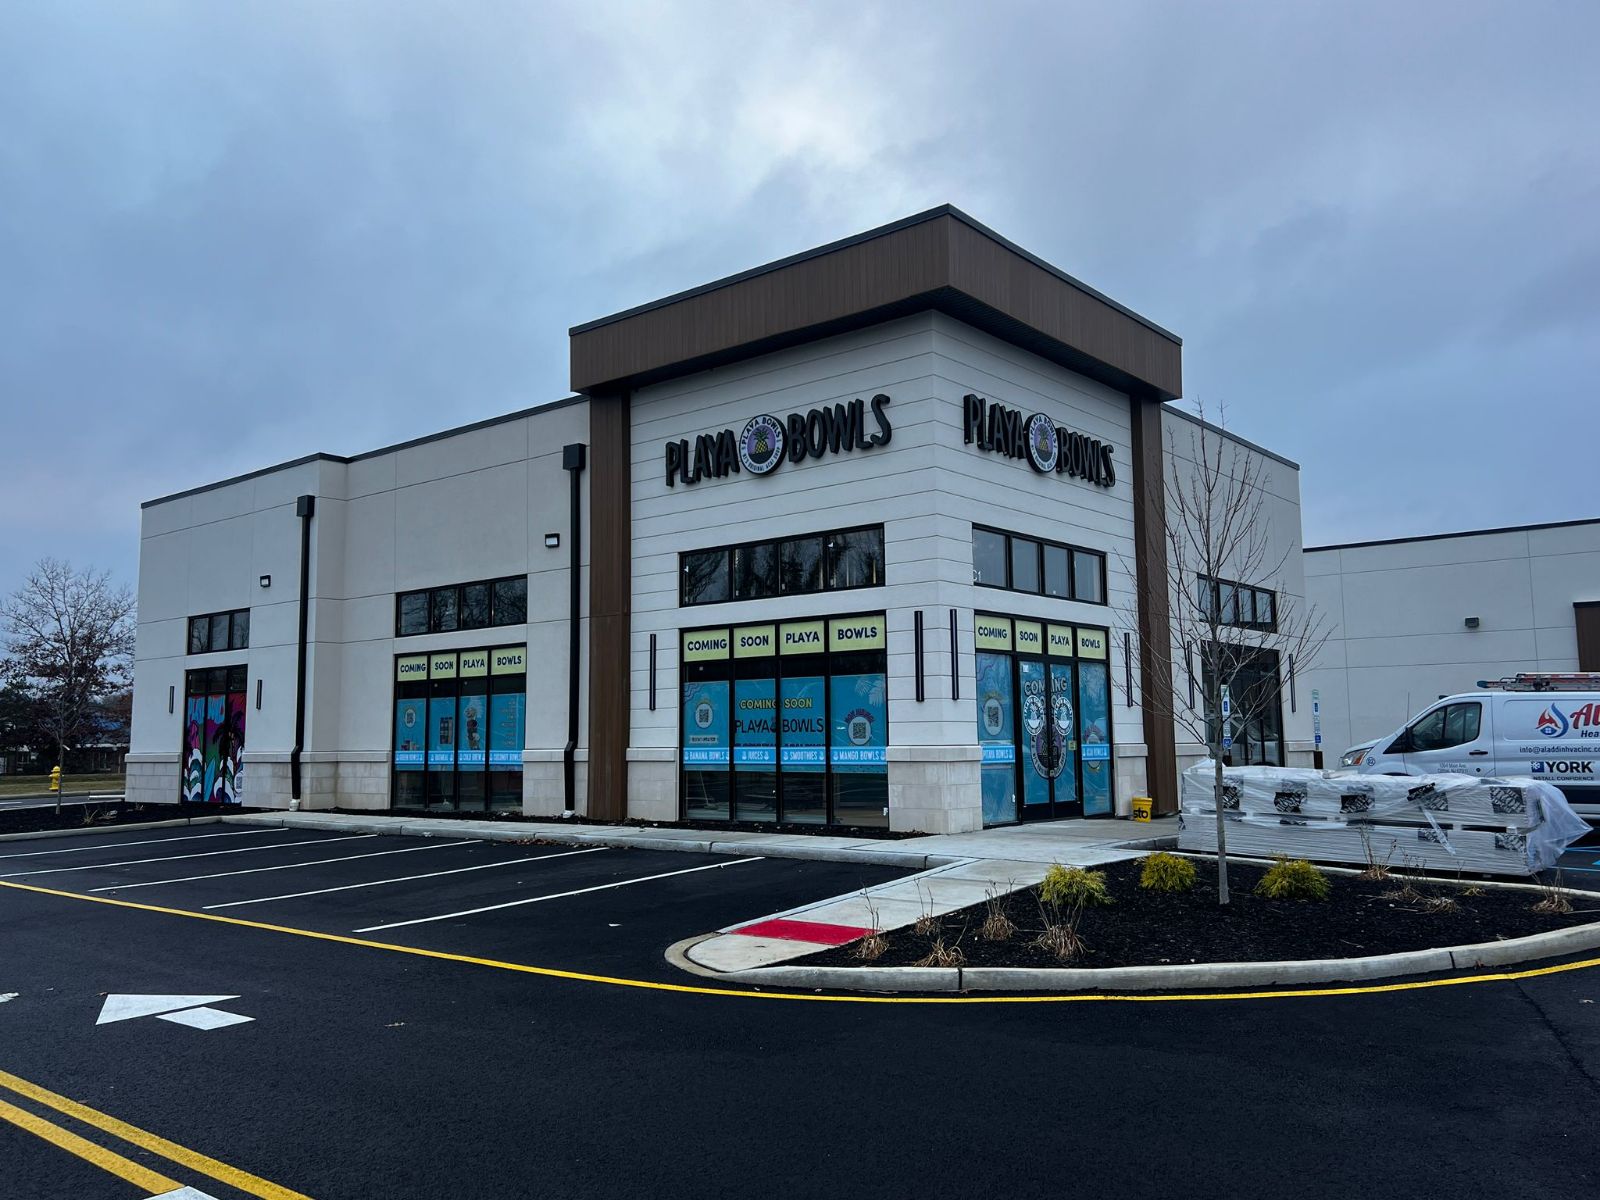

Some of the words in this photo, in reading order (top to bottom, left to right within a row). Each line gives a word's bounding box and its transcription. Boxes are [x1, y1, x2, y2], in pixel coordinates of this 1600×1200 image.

[742, 419, 760, 445] PLAYA
[762, 417, 781, 438] BOWLS
[665, 429, 740, 487] PLAYA
[787, 393, 892, 464] BOWLS
[963, 394, 1027, 459] PLAYA
[1056, 427, 1115, 487] BOWLS
[687, 638, 727, 652] COMING
[740, 635, 769, 647] SOON
[785, 631, 820, 644] PLAYA
[837, 626, 878, 640] BOWLS
[978, 626, 1008, 639] COMING
[1019, 630, 1038, 643] SOON
[1051, 634, 1070, 646] PLAYA
[1081, 638, 1100, 649] BOWLS
[400, 663, 426, 673] COMING
[434, 661, 454, 671] SOON
[463, 659, 485, 668] PLAYA
[497, 655, 522, 666] BOWLS
[784, 698, 812, 709] SOON
[734, 719, 770, 733] PLAYA
[782, 717, 824, 733] BOWLS
[690, 751, 708, 760] BANANA
[708, 751, 725, 760] BOWLS
[748, 751, 764, 761] JUICES
[789, 751, 817, 760] SMOOTHIES
[839, 750, 859, 760] MANGO
[859, 750, 880, 760] BOWLS
[1545, 761, 1594, 774] YORK
[1133, 807, 1149, 819] sto
